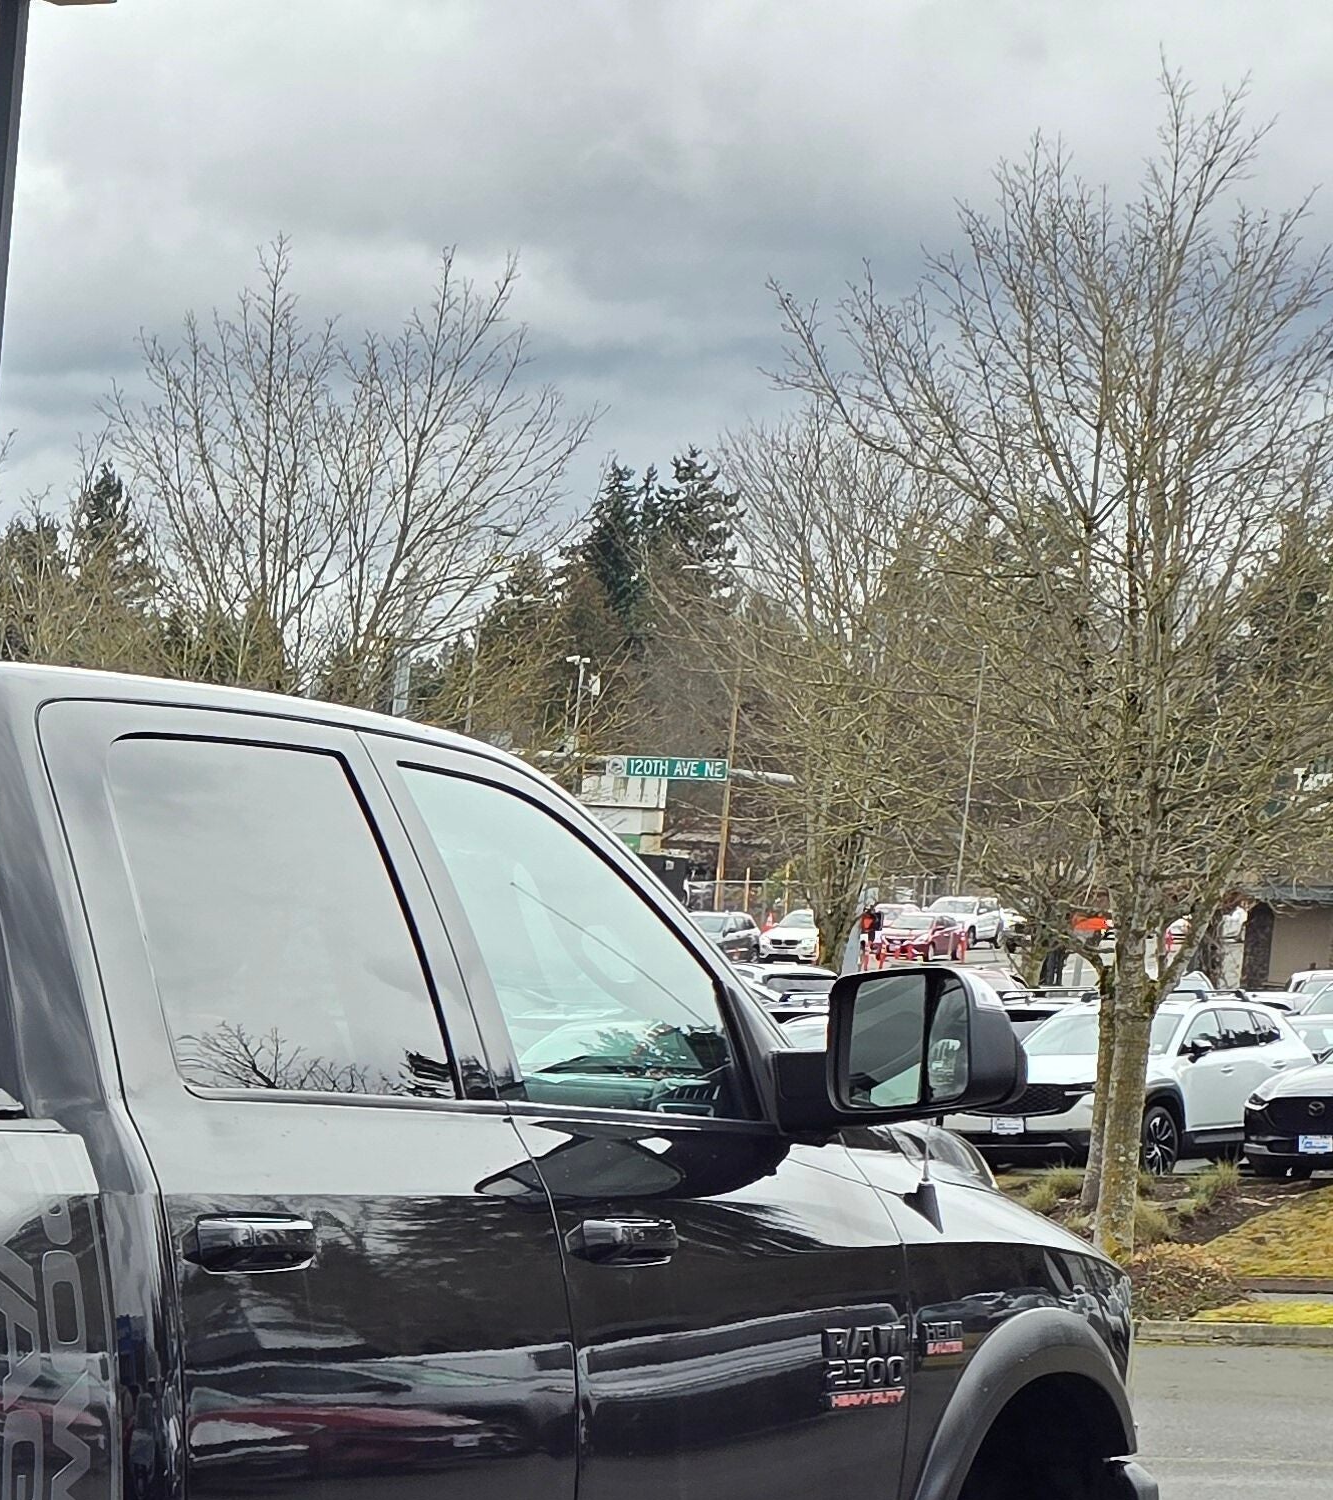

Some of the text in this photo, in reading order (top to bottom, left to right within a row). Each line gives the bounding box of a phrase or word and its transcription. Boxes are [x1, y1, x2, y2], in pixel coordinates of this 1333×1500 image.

[630, 759, 725, 778] 120TH AVE NE
[823, 1325, 907, 1357] RAM
[827, 1355, 905, 1388] 2500
[831, 1389, 905, 1408] HEAVY DUTY
